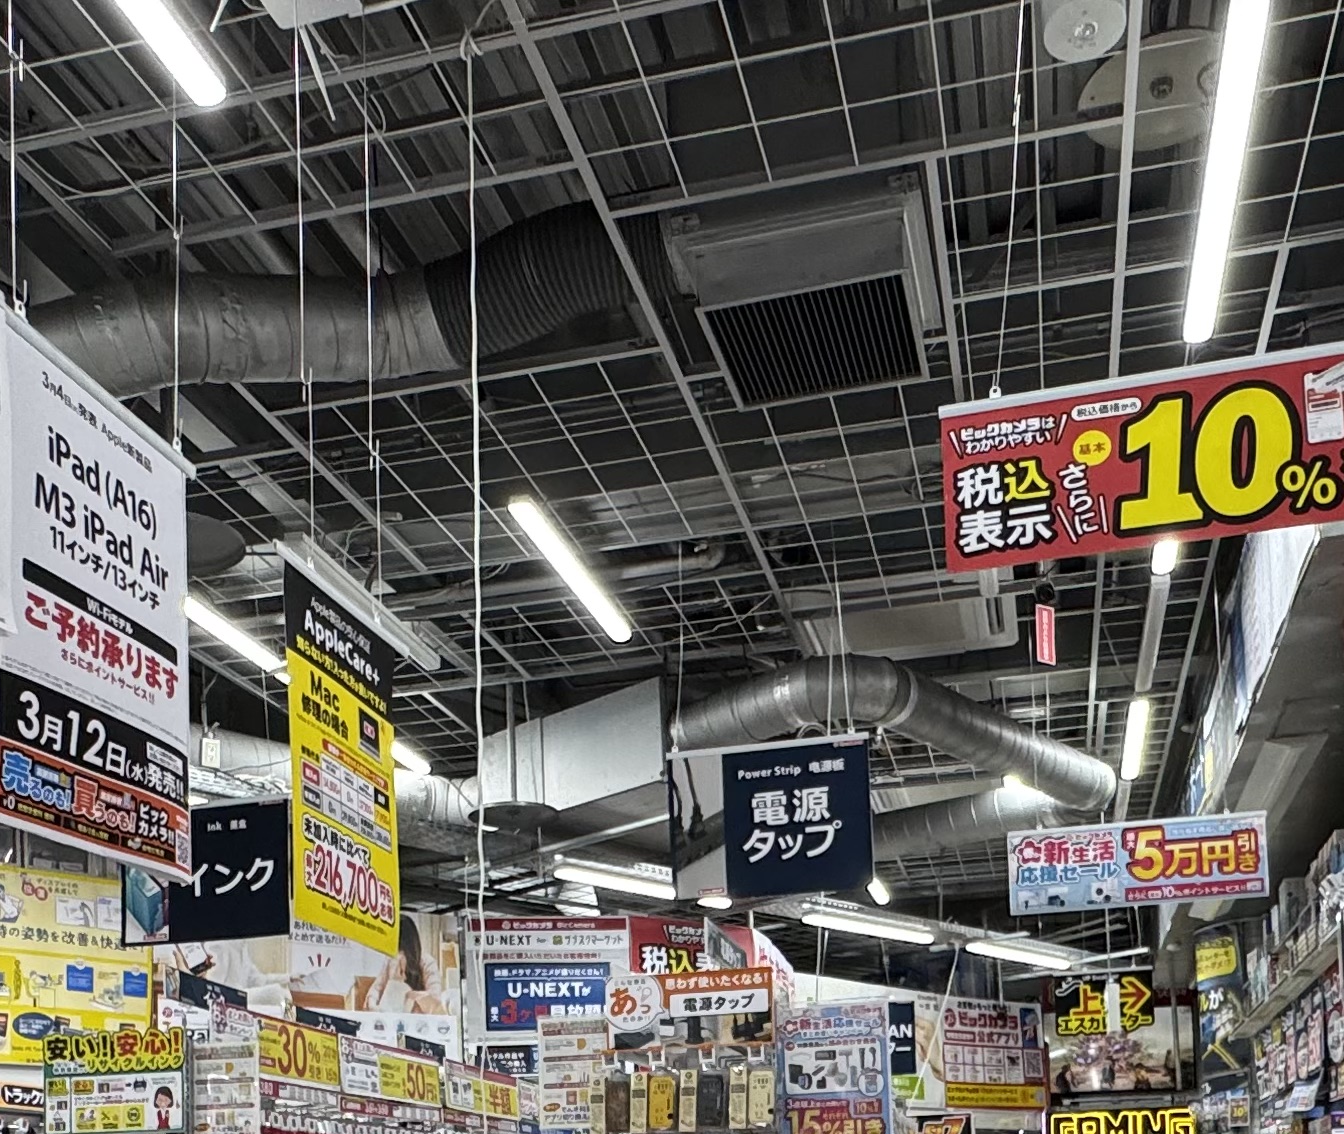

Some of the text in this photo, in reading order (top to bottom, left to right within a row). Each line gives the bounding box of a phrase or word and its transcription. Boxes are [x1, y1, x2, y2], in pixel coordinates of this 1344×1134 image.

[964, 428, 1054, 455] わかりやすい
[1078, 440, 1106, 456] 基本
[47, 427, 158, 541] iPad (A16)
[957, 462, 1052, 507] 税込
[35, 474, 170, 592] M3 iPad Air
[958, 506, 1053, 555] 表示
[50, 525, 160, 611] 11インチ/13インチ
[24, 589, 179, 700] ご予約承ります
[304, 610, 380, 686] AppleCare+
[310, 670, 340, 712] Mac
[737, 763, 802, 780] Power Strip
[751, 786, 830, 825] 電源
[742, 820, 843, 864] タップ
[1044, 839, 1116, 864] 新生活
[189, 856, 274, 897] インク
[313, 844, 379, 914] 216,700
[1019, 863, 1119, 885] 応援セール
[683, 993, 756, 1013] 電源タップ
